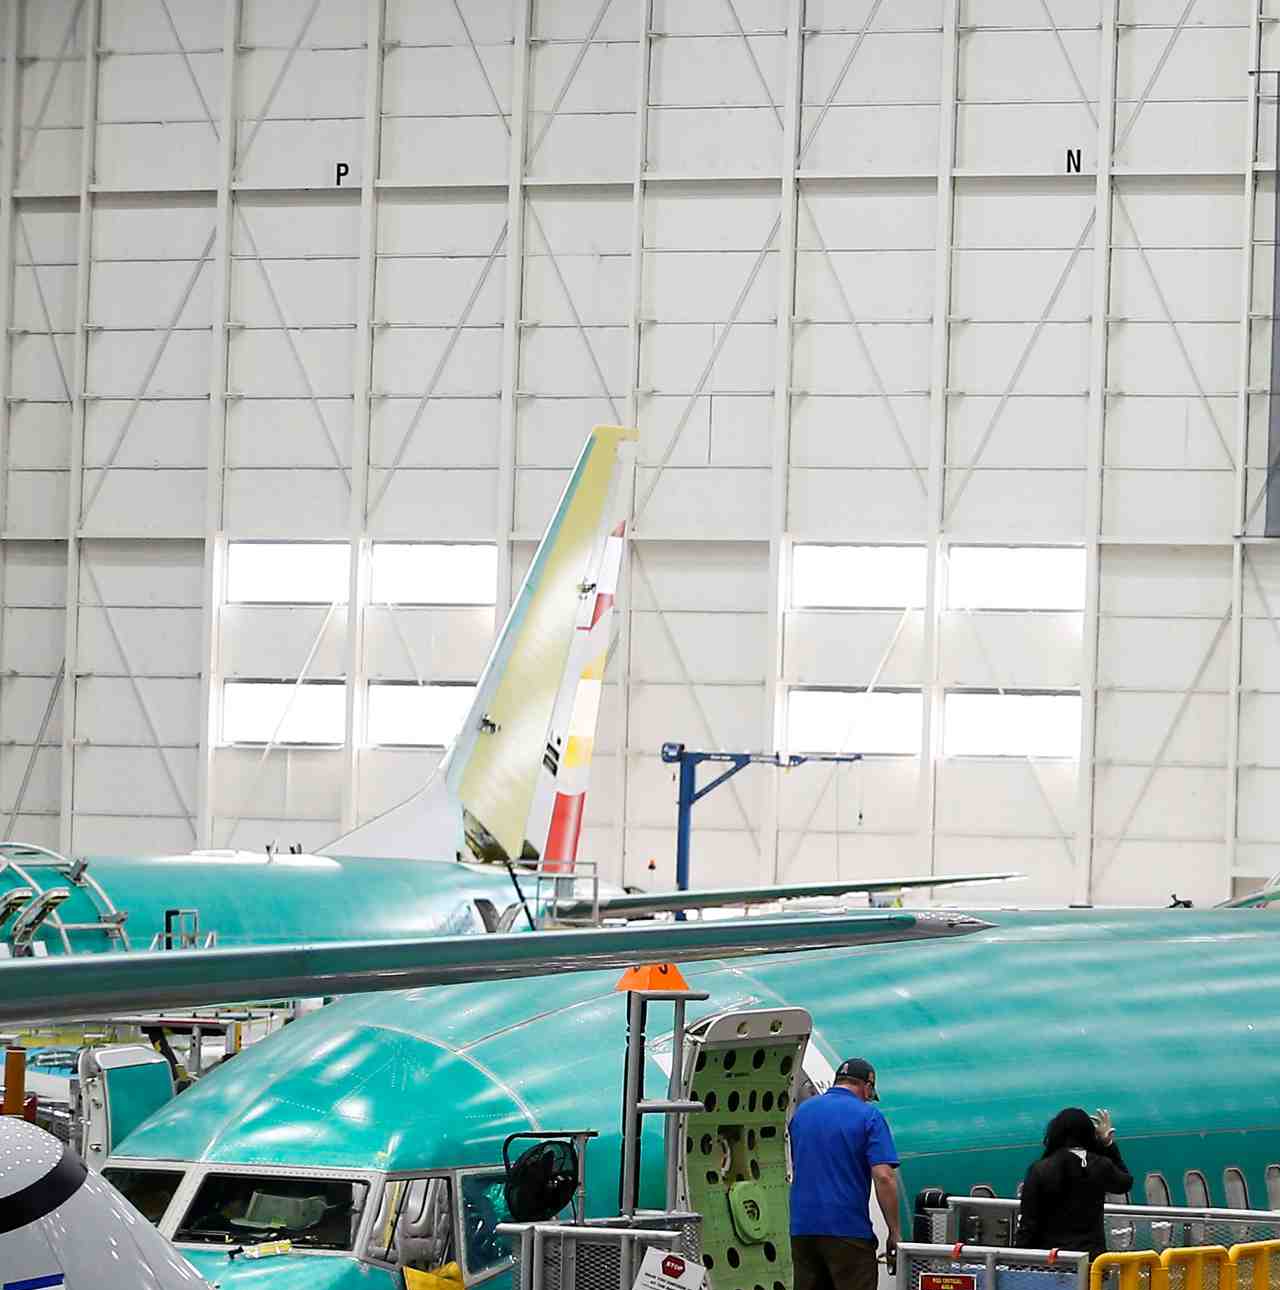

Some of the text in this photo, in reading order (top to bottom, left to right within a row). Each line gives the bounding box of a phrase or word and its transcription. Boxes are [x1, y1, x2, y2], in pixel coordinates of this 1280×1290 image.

[1066, 149, 1082, 174] N
[336, 162, 350, 185] P
[665, 1260, 684, 1272] STOP
